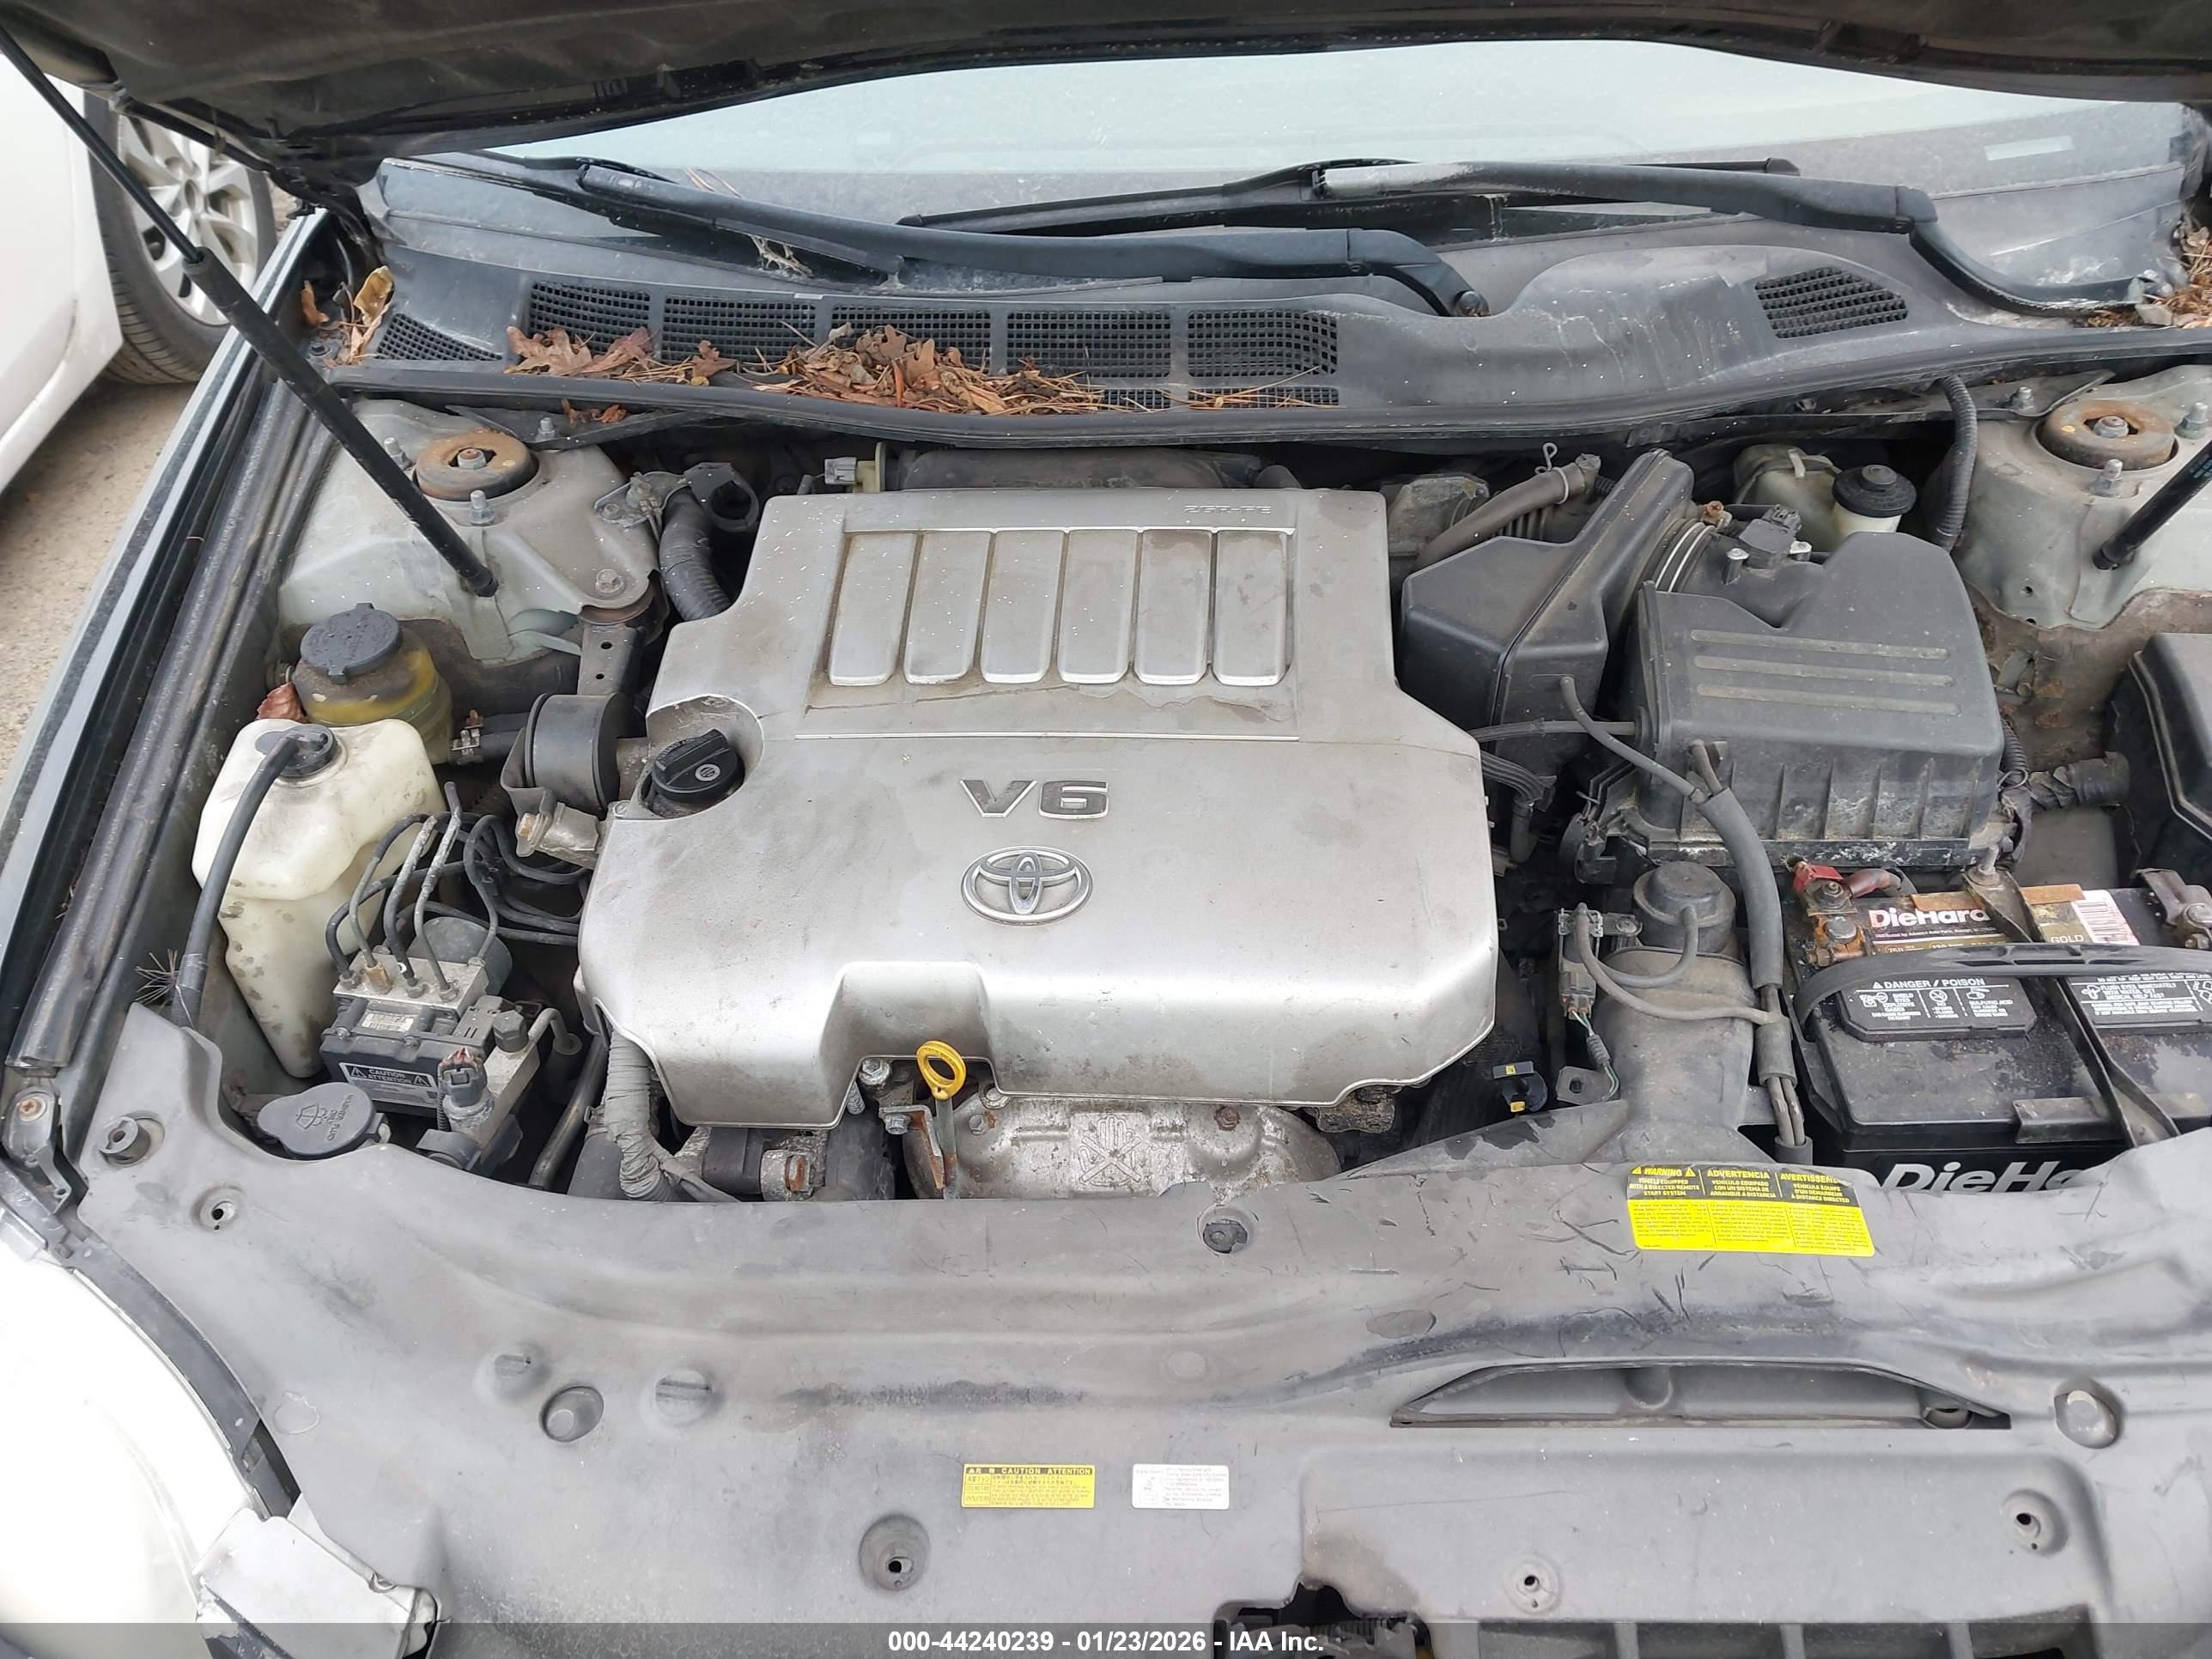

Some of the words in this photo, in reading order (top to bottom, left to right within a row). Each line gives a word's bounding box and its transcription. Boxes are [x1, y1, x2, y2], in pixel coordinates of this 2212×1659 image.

[959, 779, 1109, 819] V6
[2051, 934, 2084, 944] GOLD
[1883, 980, 1931, 989] DANGER
[1932, 979, 1939, 988] /
[1942, 978, 1985, 987] POISON
[368, 1069, 406, 1079] CAUTION
[368, 1074, 412, 1085] ATTENTION
[1644, 1167, 1683, 1177] WARNING
[1707, 1170, 1771, 1179] ADVERTENCIA
